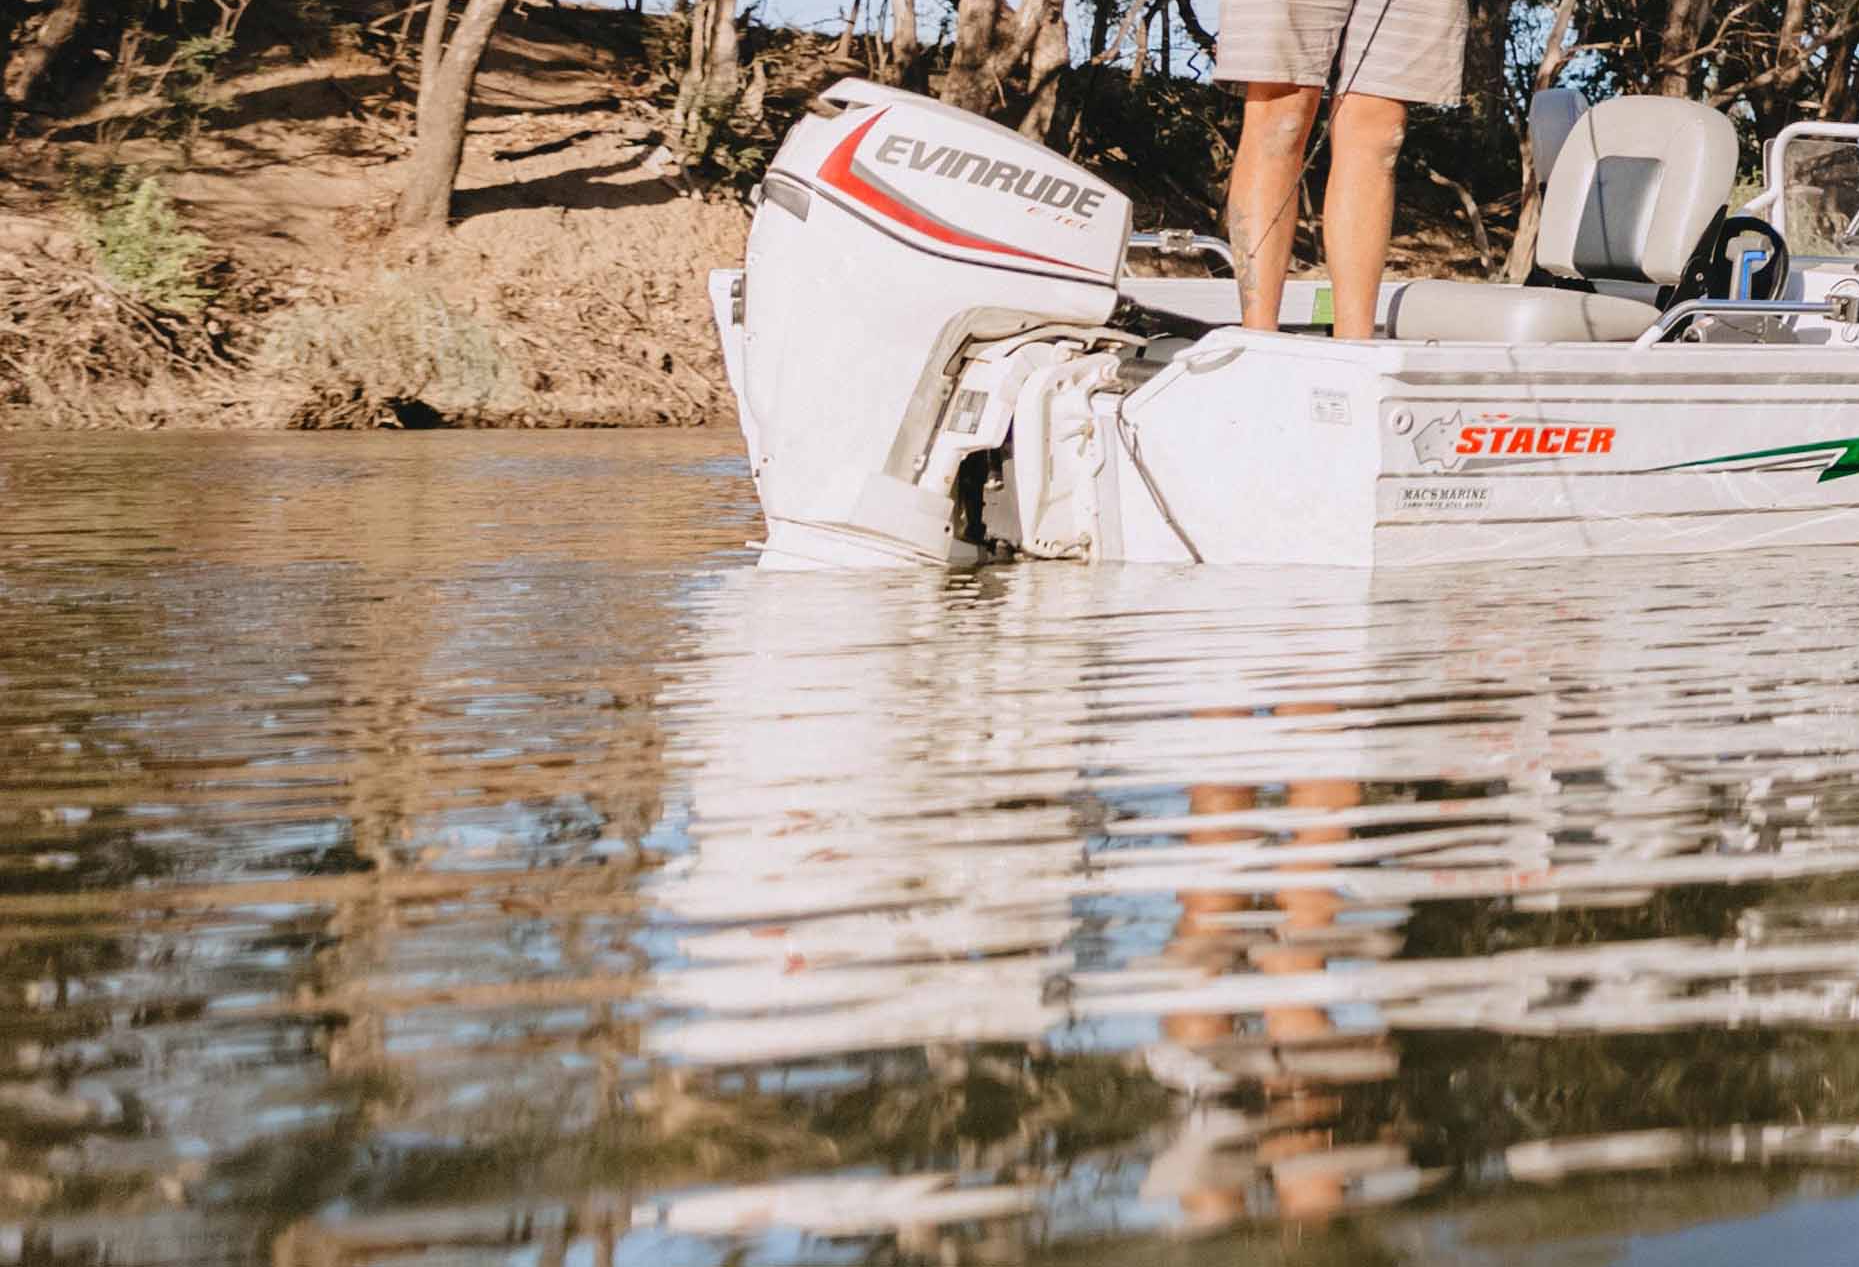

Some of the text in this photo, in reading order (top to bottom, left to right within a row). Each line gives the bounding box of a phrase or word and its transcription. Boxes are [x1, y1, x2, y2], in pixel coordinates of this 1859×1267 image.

[875, 135, 1106, 218] EVINRUDE
[1455, 427, 1616, 455] STACER
[1440, 487, 1487, 500] MARINE
